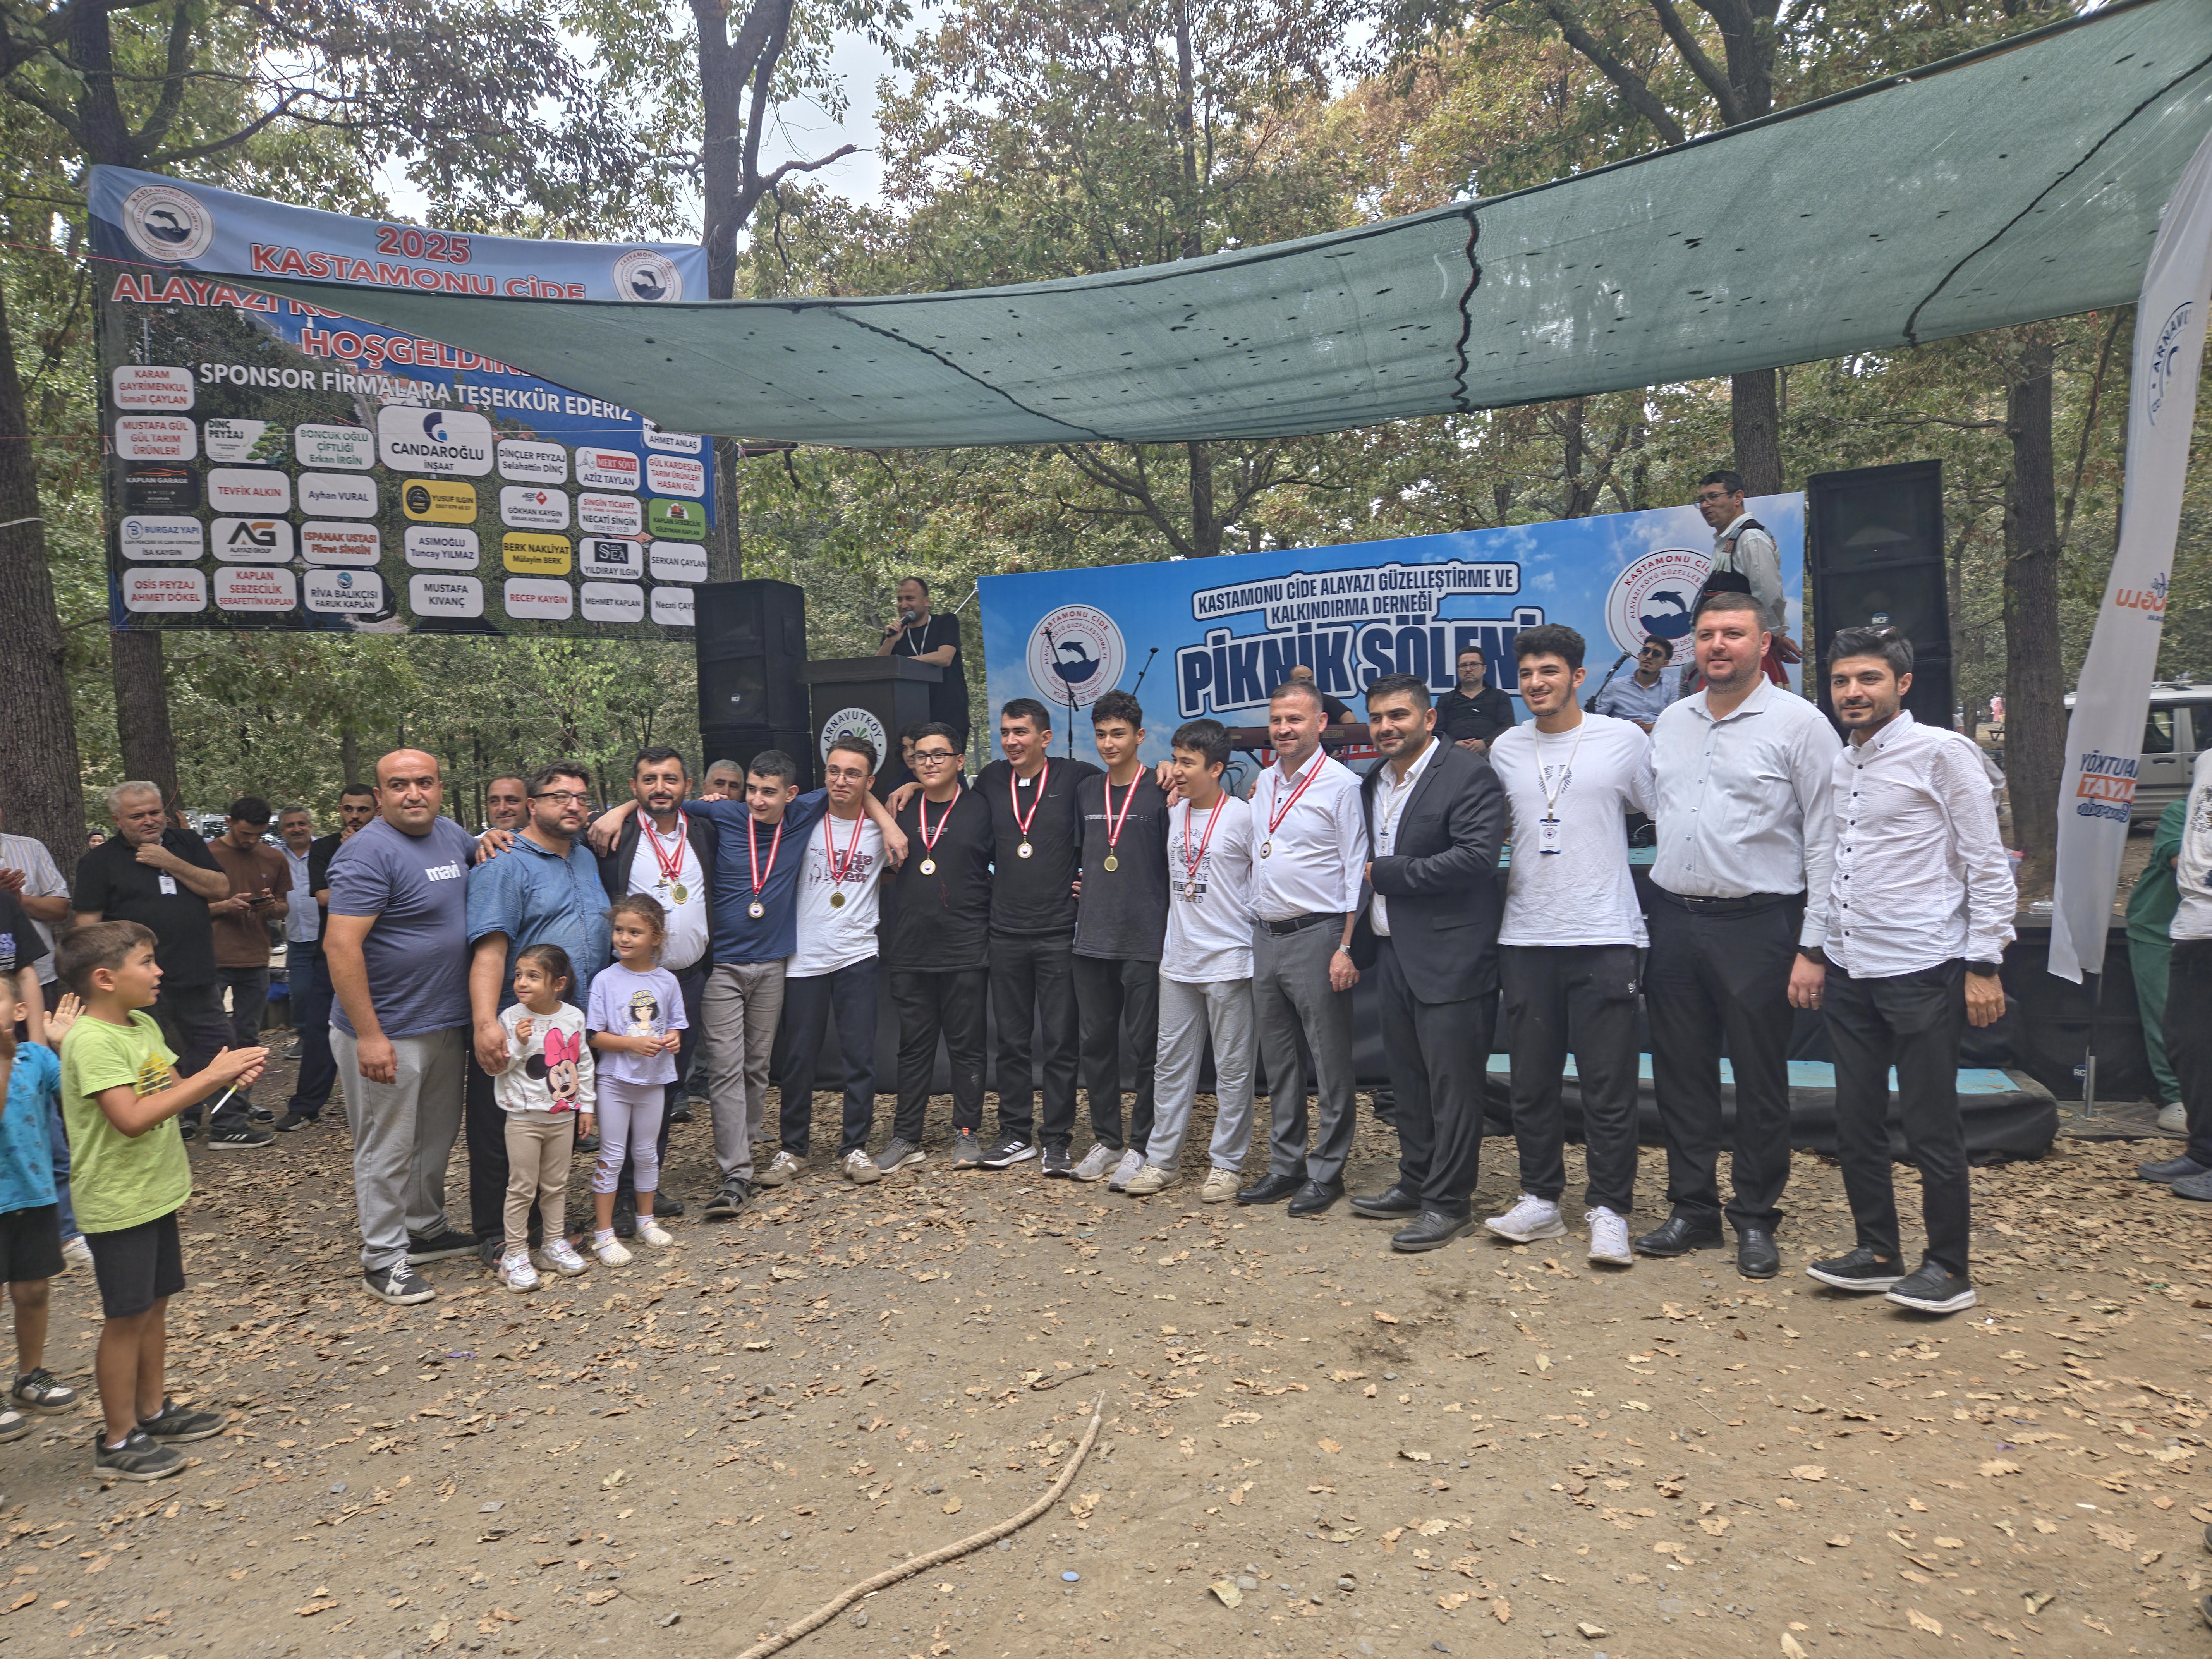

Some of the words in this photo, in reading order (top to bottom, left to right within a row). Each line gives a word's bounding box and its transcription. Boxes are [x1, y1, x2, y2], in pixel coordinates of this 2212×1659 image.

[376, 226, 470, 264] 2025
[251, 243, 496, 296] KASTAMONU
[504, 275, 586, 299] CİDE
[135, 370, 170, 379] KARAM
[120, 381, 188, 392] GAYRİMENKUL
[200, 363, 316, 390] SPONSOR
[323, 367, 451, 402] FİRMALARA
[454, 384, 560, 413] TEŞEKKÜR
[149, 395, 187, 405] ÇAYLAN
[123, 421, 169, 430] MUSTAFA
[170, 421, 188, 431] GÜL
[131, 432, 150, 442] GÜL
[152, 434, 181, 443] TARIM
[300, 429, 341, 440] BONCUK
[343, 431, 369, 442] OĞLU
[649, 436, 674, 445] AHMET
[133, 445, 180, 455] ÜRÜNLERİ
[391, 442, 484, 461] CANDAROĞLU
[500, 448, 534, 460] DİNÇLER
[536, 453, 565, 463] PEYZAJ
[309, 455, 335, 464] Erkan
[424, 459, 453, 471] İNŞAAT
[543, 463, 564, 476] DİNÇ
[649, 458, 663, 467] GÜL
[664, 460, 702, 473] KARDEŞLER
[584, 472, 602, 482] AZİZ
[604, 476, 635, 486] TAYLAN
[651, 469, 671, 478] TARIM
[657, 480, 681, 489] HASAN
[682, 481, 696, 491] GÜL
[218, 486, 251, 496] TEVFİK
[253, 488, 281, 497] ALKIN
[308, 491, 337, 501] Ayhan
[338, 492, 369, 501] VURAL
[608, 499, 634, 509] TİCARET
[508, 506, 537, 515] GÖKHAN
[583, 515, 610, 524] NECATİ
[144, 526, 179, 534] BURGAZ
[304, 532, 344, 542] ISPANAK
[346, 534, 377, 543] USTASI
[419, 537, 465, 547] ASIMOĞLU
[312, 544, 337, 553] Fikret
[410, 549, 440, 559] Tuncay
[441, 550, 474, 559] YILMAZ
[504, 543, 526, 551] BERK
[528, 543, 570, 554] NAKLİYAT
[543, 556, 562, 565] BERK
[652, 556, 679, 565] SERKAN
[682, 558, 706, 568] ÇAYLAN
[236, 571, 274, 580] KAPLAN
[1624, 556, 1691, 586] KASTAMONU
[134, 579, 157, 589] OSİS
[159, 581, 194, 589] PEYZAJ
[424, 584, 469, 593] MUSTAFA
[311, 587, 331, 598] RİVA
[335, 590, 378, 601] BALIKÇISI
[1198, 584, 1282, 614] KASTAMONU
[1286, 574, 1316, 599] CİDE
[1321, 573, 1374, 595] ALAYAZI
[1379, 566, 1491, 590] GÜZELLEŞTİRME
[1496, 568, 1513, 588] VE
[1630, 589, 1641, 618] ALAYAZI
[1640, 573, 1659, 588] KÖYÜ
[168, 592, 201, 602] DÖKEL
[265, 598, 294, 606] KAPLAN
[429, 596, 465, 608] KIVANÇ
[510, 594, 536, 602] RECEP
[537, 595, 568, 604] KAYGIN
[585, 598, 613, 606] MEHMET
[1271, 597, 1369, 624] KALKINDIRMA
[1372, 591, 1432, 616] DERNEĞİ
[1040, 611, 1088, 636] KASTAMONU
[1092, 615, 1109, 631] CİDE
[1182, 622, 1350, 711] PİKNİK
[823, 711, 883, 743] ARNAVUTKÖY
[426, 860, 461, 882] mavi
